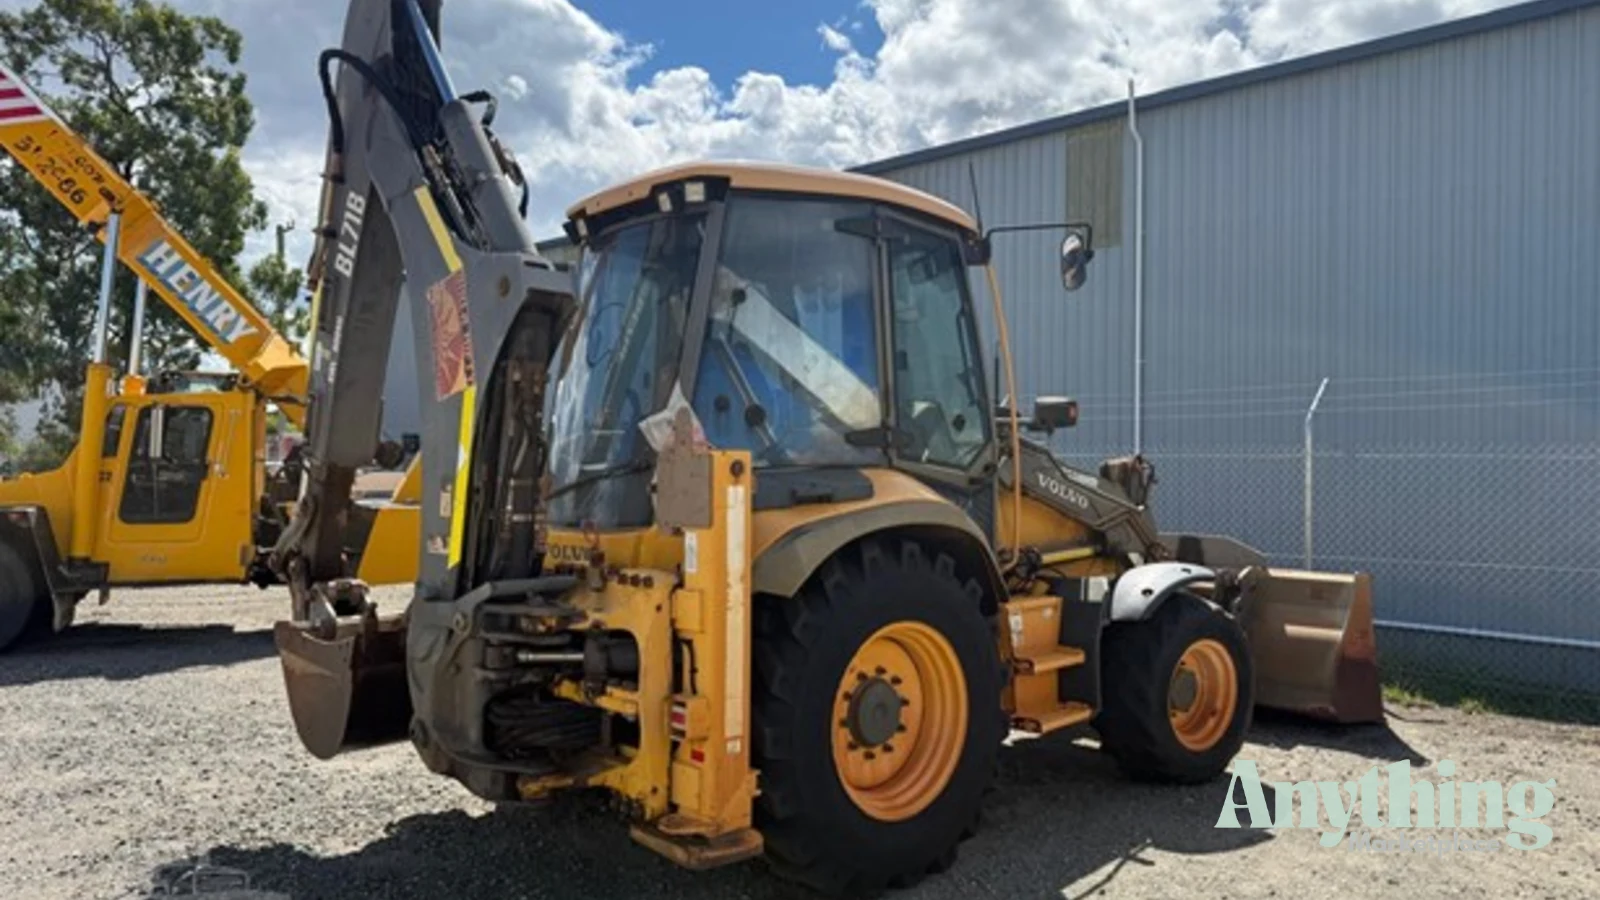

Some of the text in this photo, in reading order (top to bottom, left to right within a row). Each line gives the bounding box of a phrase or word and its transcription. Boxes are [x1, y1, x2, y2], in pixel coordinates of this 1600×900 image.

[334, 190, 366, 278] BL71B
[138, 239, 259, 345] HENRY
[1036, 472, 1089, 509] VOLVO
[546, 543, 591, 561] OLV
